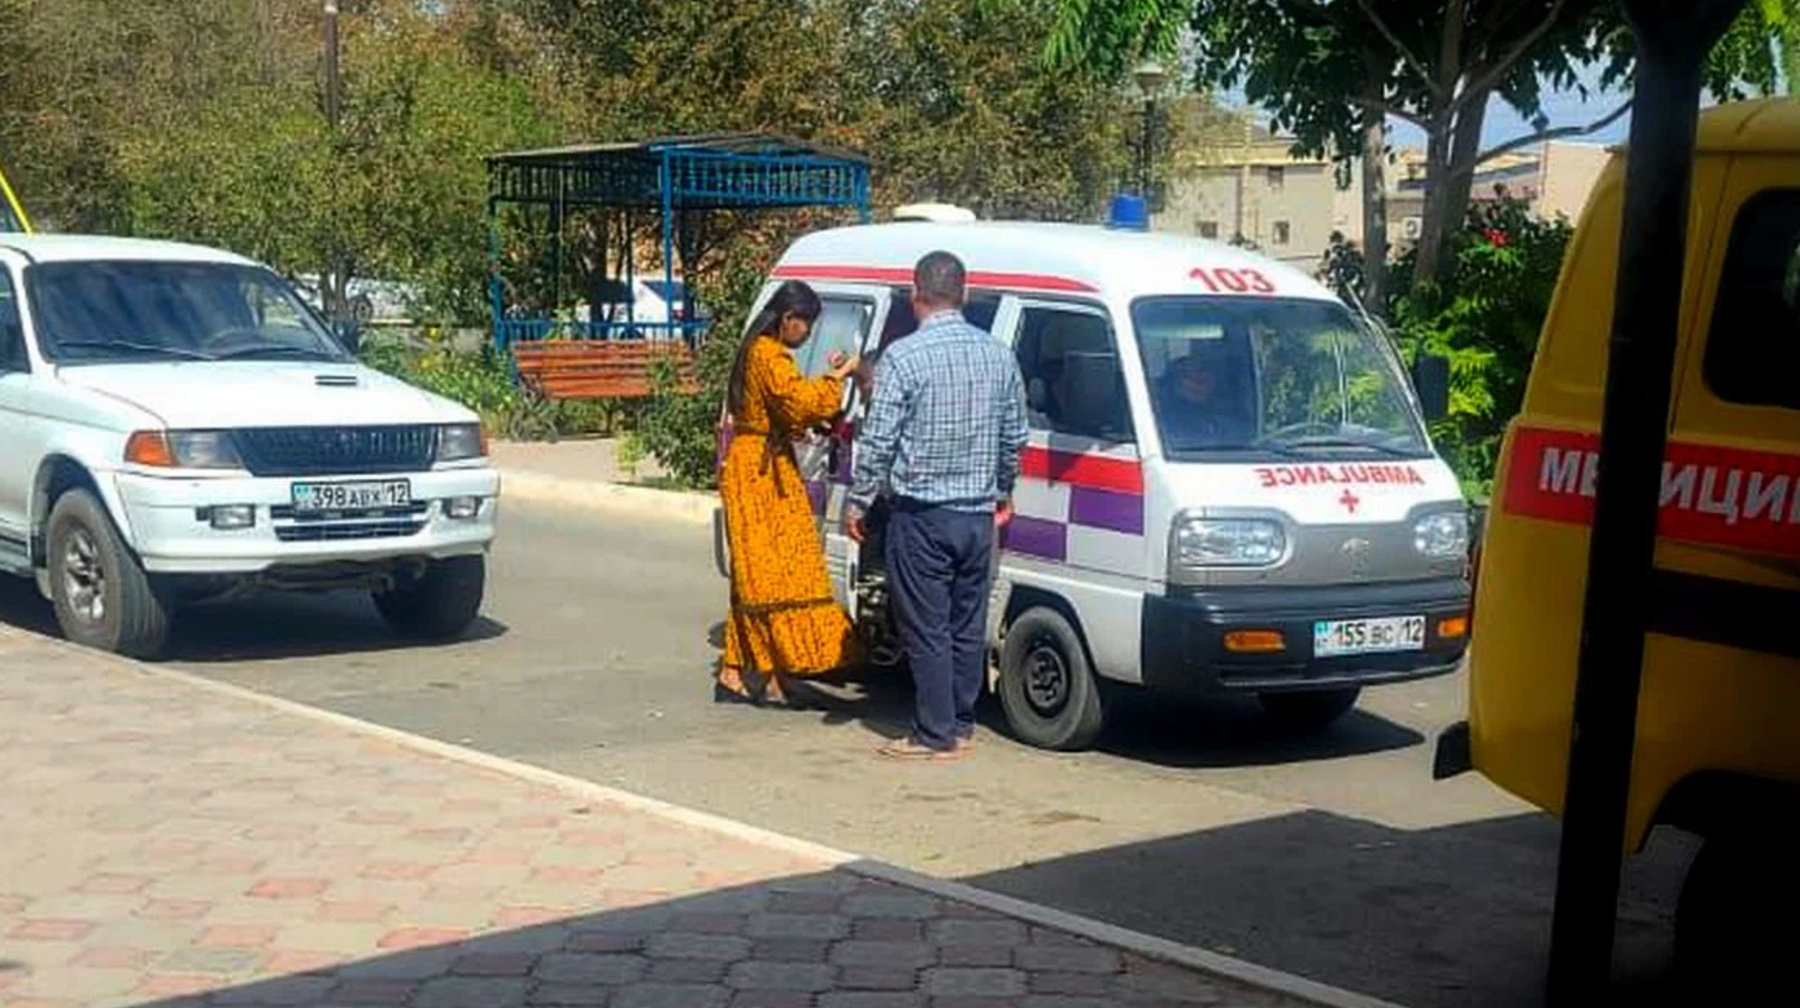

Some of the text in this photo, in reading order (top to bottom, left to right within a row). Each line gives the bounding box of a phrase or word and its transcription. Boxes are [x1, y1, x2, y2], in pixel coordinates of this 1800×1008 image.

[1189, 267, 1275, 292] 103
[312, 486, 346, 507] 398
[386, 484, 406, 505] 12
[1539, 446, 1800, 525] МЕИЦИ
[1335, 622, 1367, 645] 155
[1403, 618, 1425, 642] 12
